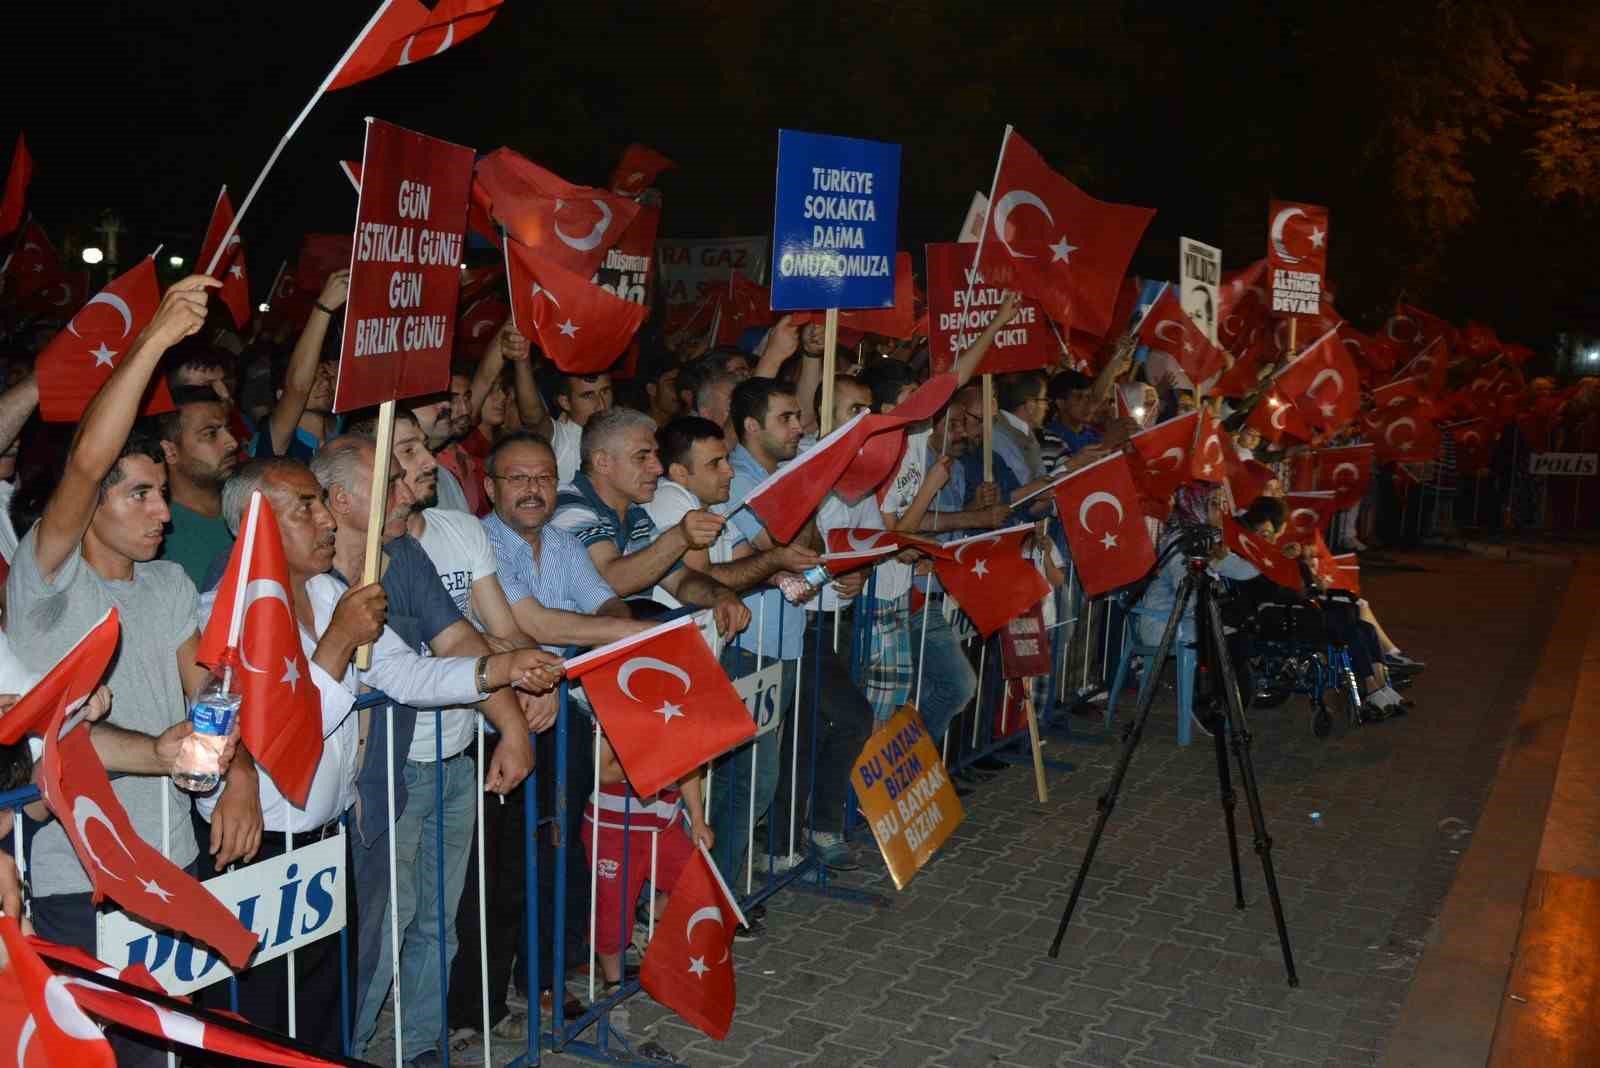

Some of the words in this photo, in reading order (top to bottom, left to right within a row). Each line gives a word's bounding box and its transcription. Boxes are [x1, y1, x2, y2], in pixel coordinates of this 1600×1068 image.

[812, 167, 873, 194] TÜRKİYE
[399, 180, 431, 220] GÜN
[803, 195, 876, 221] SOKAKTA
[357, 222, 414, 264] İSTİKLAL
[418, 228, 462, 267] GÜNÜ
[812, 225, 865, 249] DAİMA
[832, 254, 889, 277] OMUZA
[389, 271, 423, 309] GÜN
[1273, 297, 1320, 314] DEVAM
[354, 317, 400, 357] BİRLİK
[403, 315, 447, 351] GÜNÜ
[994, 328, 1027, 349] ÇIKTI
[1536, 456, 1594, 473] POLİS
[860, 756, 884, 788] BU
[881, 719, 924, 767] VATAN
[876, 809, 899, 846] BU
[897, 761, 944, 823] BAYRAK
[904, 801, 943, 852] BİZİM
